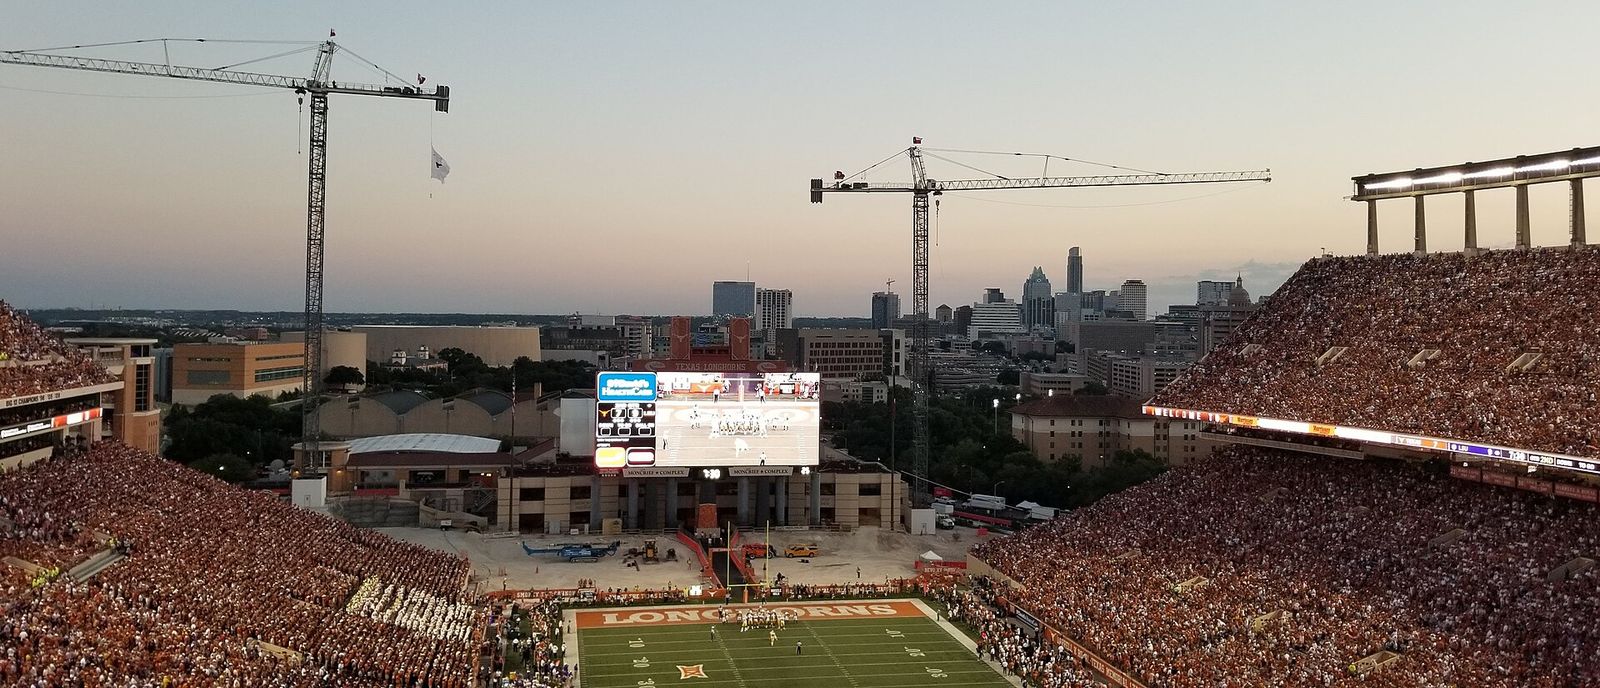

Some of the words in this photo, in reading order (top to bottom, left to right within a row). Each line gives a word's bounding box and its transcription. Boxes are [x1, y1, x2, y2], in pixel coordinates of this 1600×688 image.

[675, 363, 700, 371] TEXAS
[703, 363, 746, 371] LONGHORNS
[1155, 406, 1201, 420] WELCOME
[602, 604, 897, 625] LONGORNS
